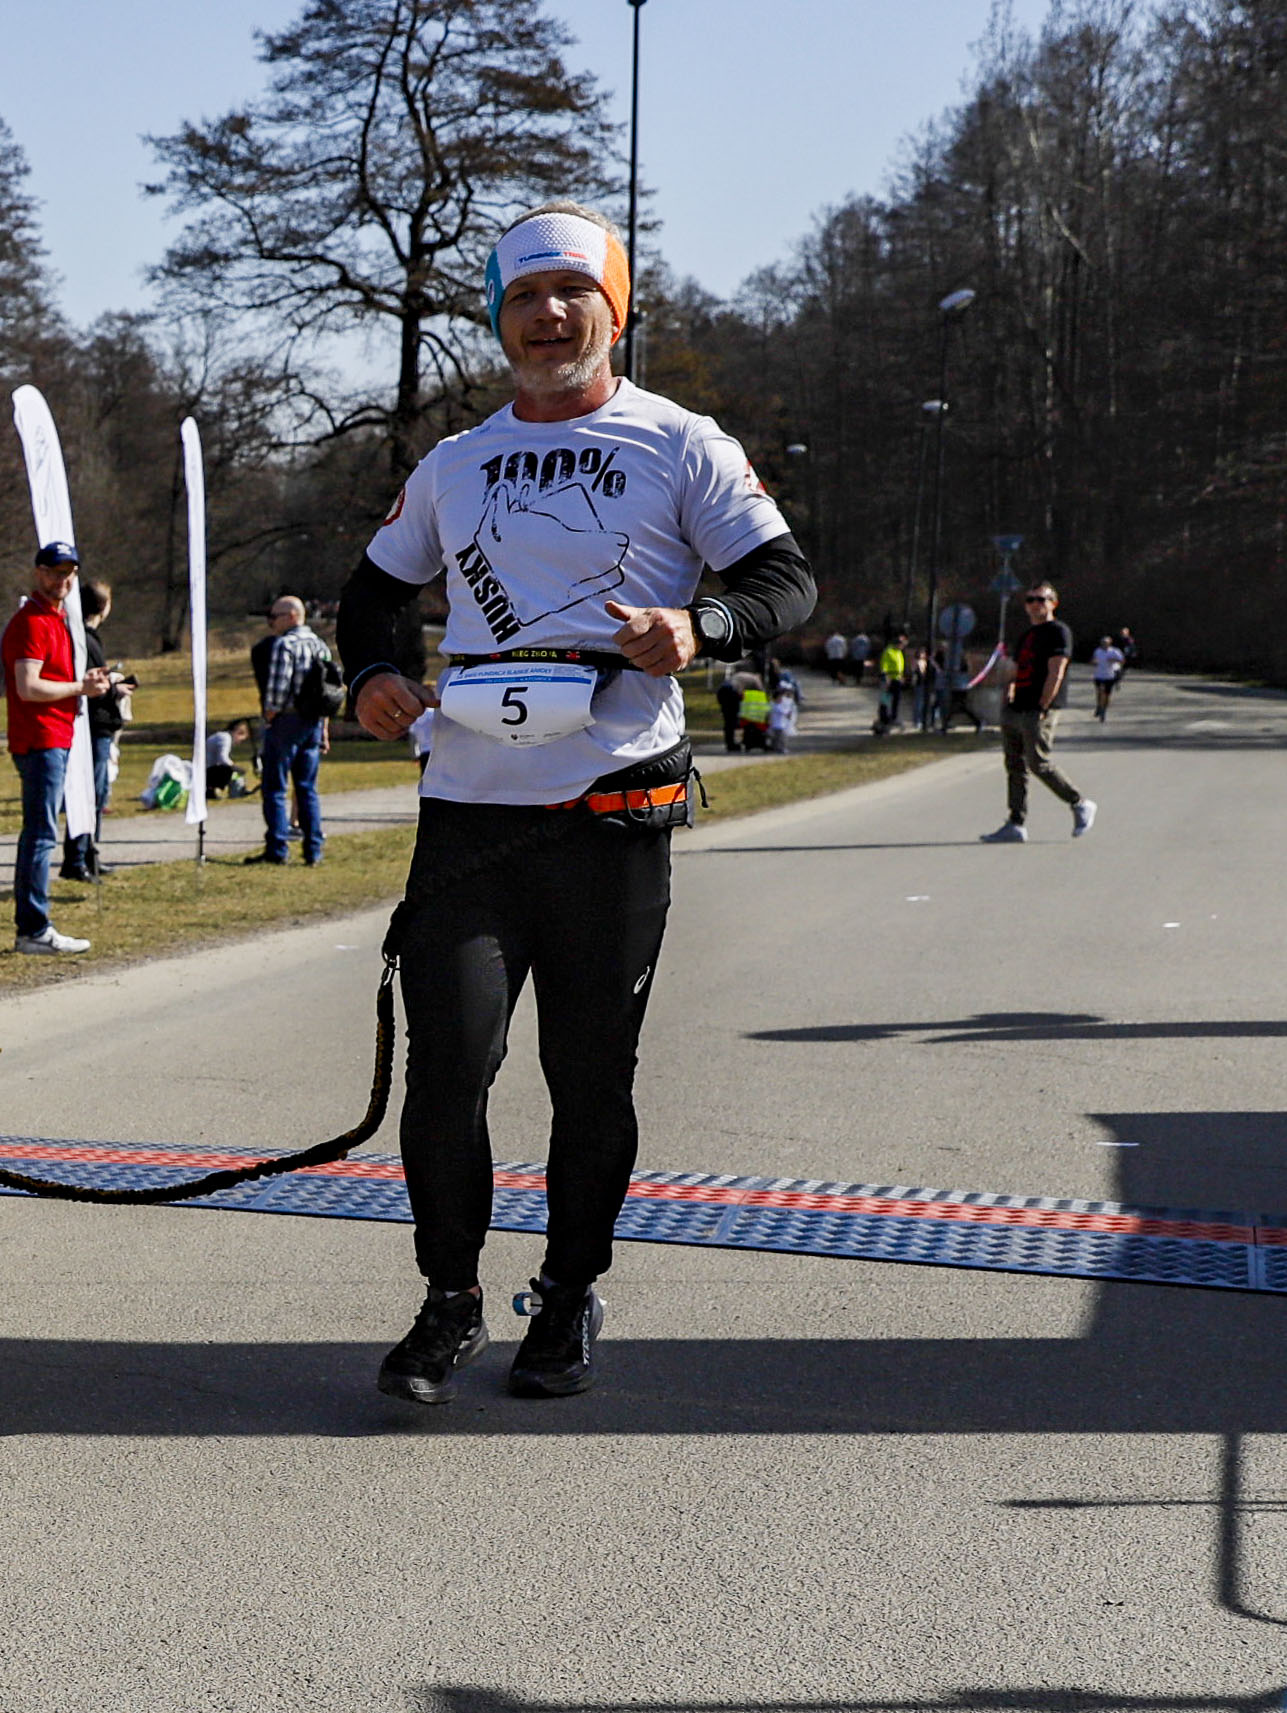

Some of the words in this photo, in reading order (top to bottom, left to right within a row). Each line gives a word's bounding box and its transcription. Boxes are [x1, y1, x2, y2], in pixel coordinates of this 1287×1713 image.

[480, 447, 626, 499] 100%
[455, 542, 521, 645] HUSKY
[500, 686, 529, 725] 5
